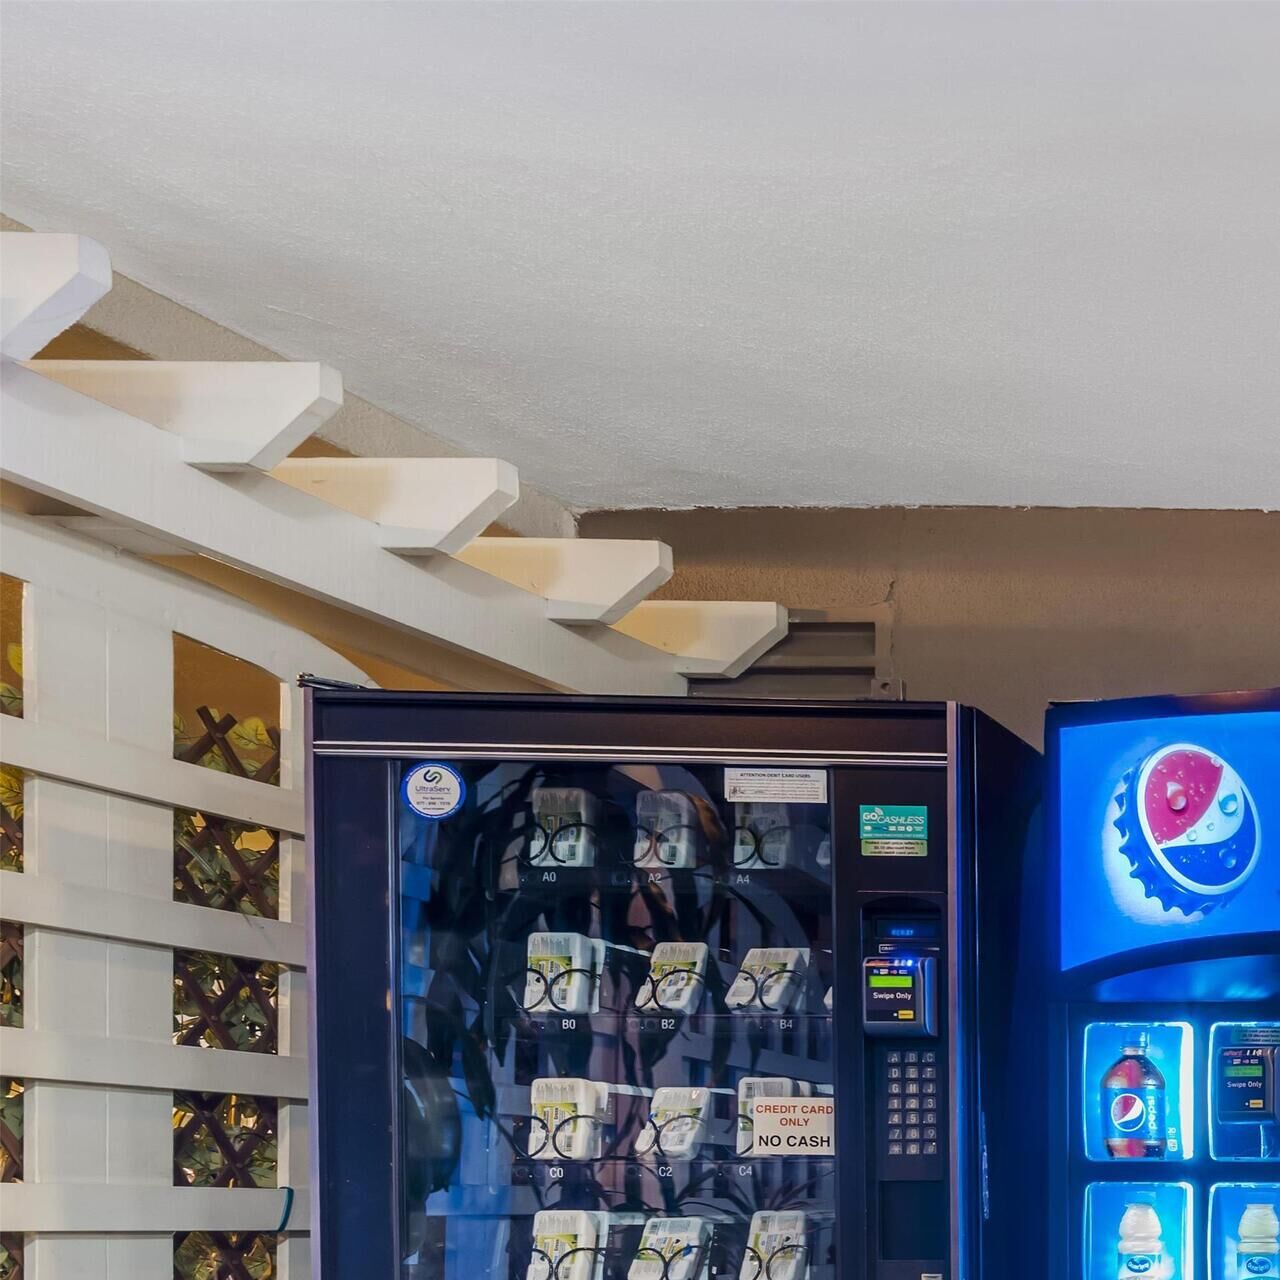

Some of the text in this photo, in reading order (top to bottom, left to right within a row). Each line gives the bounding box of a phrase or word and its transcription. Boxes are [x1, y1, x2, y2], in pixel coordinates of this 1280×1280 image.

[863, 812, 925, 824] GO CASHLESS
[648, 873, 662, 884] A2
[736, 874, 750, 884] A4
[873, 992, 912, 1000] Swipe Only
[661, 1019, 675, 1030] B2
[779, 1019, 793, 1029] B4
[756, 1104, 834, 1115] CREDIT CARD
[1148, 1095, 1157, 1131] pepsi
[779, 1117, 810, 1127] ONLY
[758, 1135, 831, 1148] NO CASH
[658, 1166, 673, 1177] C2
[738, 1166, 752, 1176] C4
